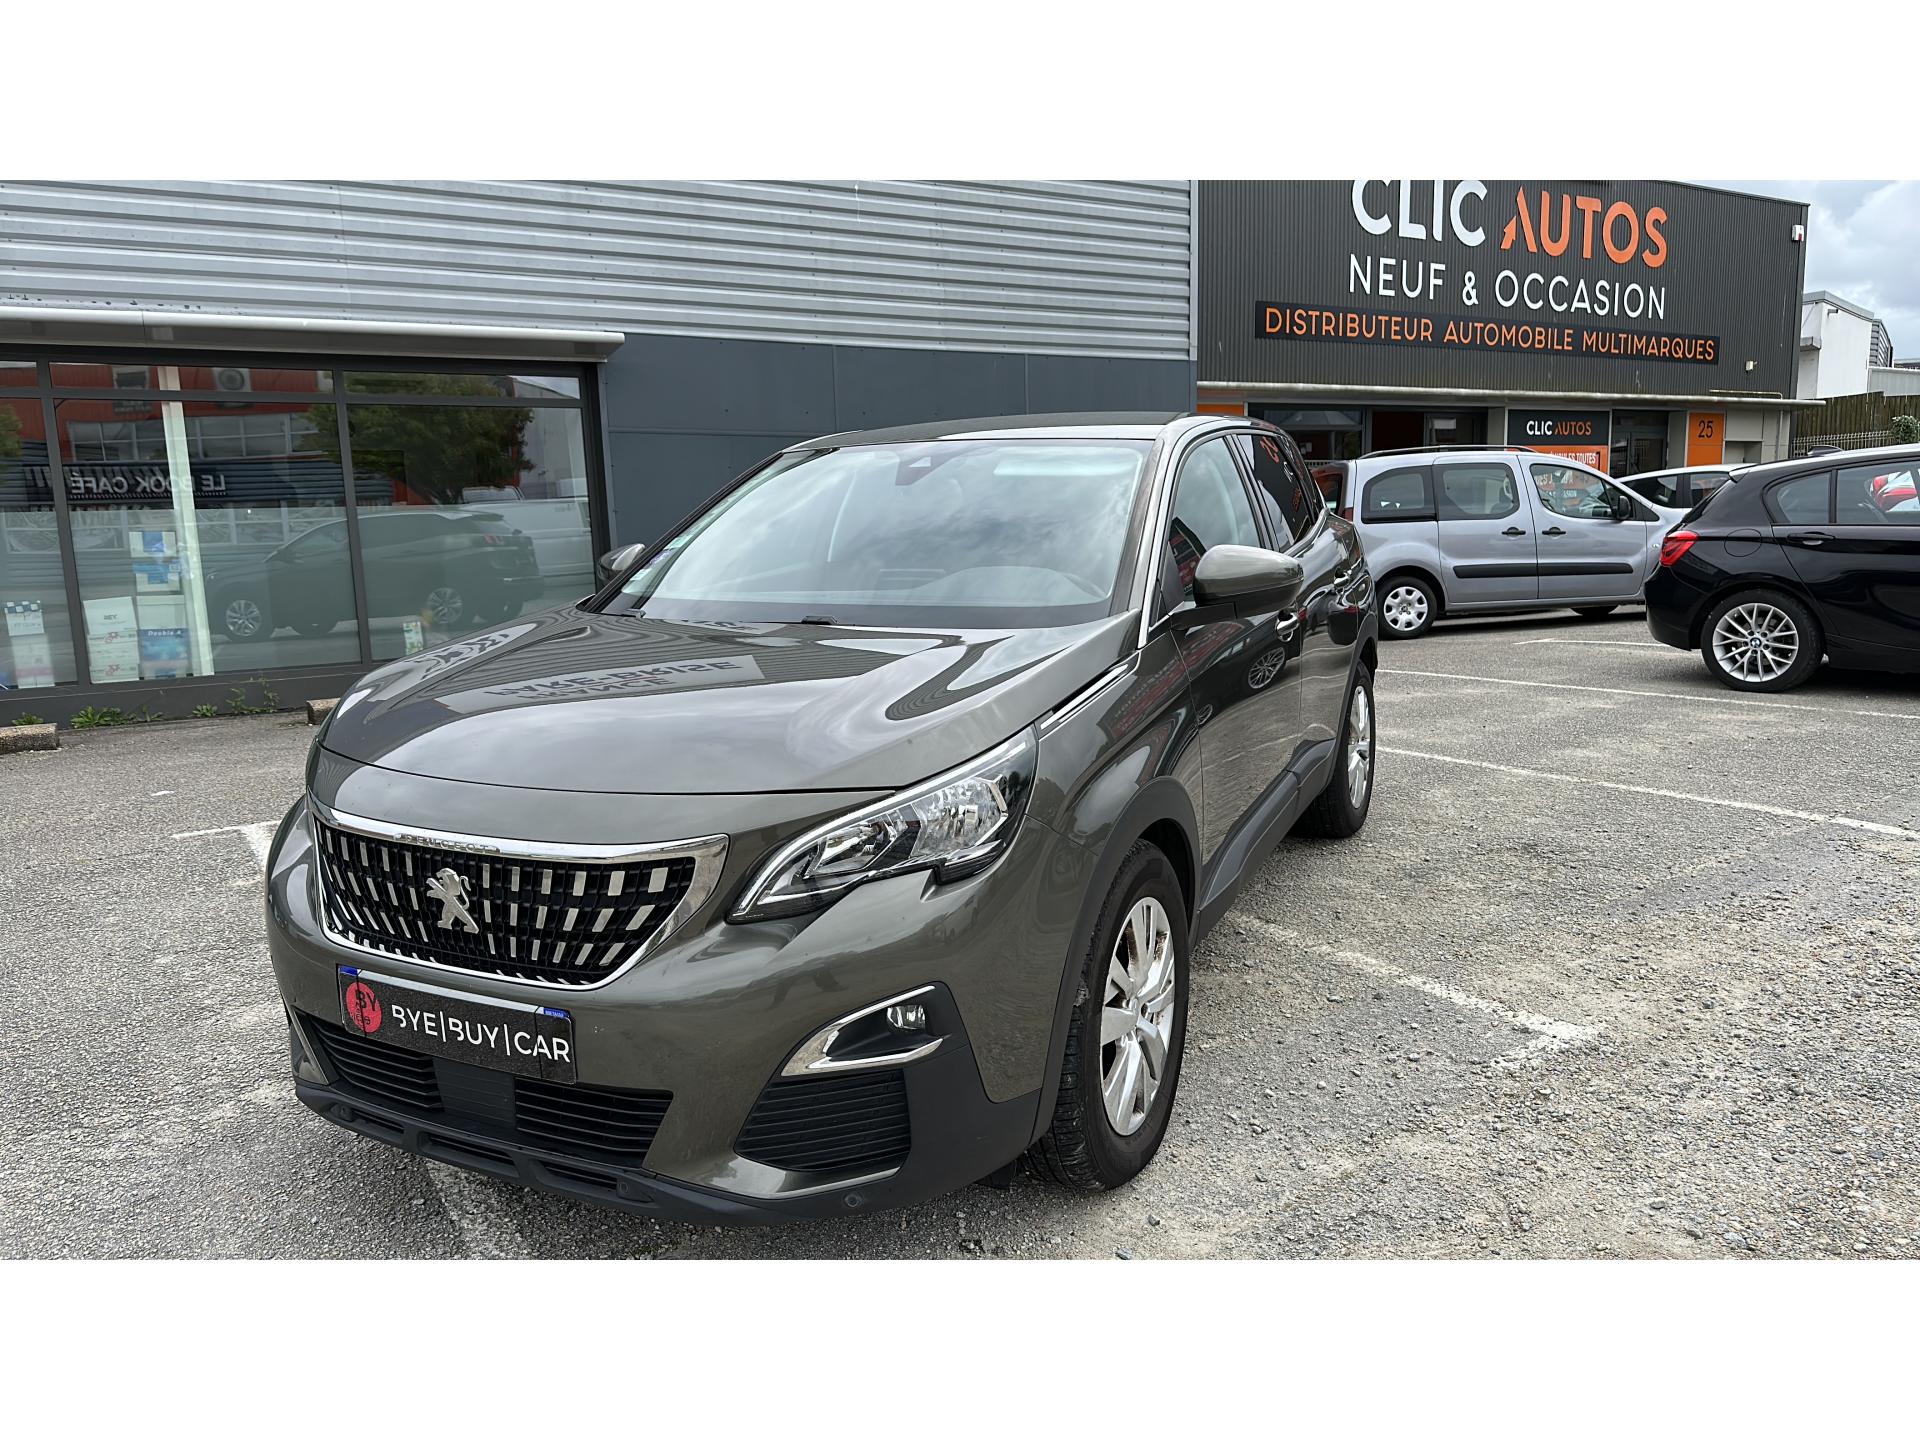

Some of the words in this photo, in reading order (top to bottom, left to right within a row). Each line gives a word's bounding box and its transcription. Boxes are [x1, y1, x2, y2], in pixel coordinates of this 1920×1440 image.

[1351, 180, 1488, 247] CLIC
[1501, 185, 1668, 268] AUTOS
[1349, 253, 1446, 300] NEUF
[1462, 270, 1479, 306] &
[1495, 269, 1666, 320] OCCASION
[1265, 306, 1434, 342] DISTRIBUTEUR
[1444, 320, 1573, 351] AUTOMOBILE
[1583, 331, 1715, 361] MULTIMARQUES
[1526, 420, 1553, 436] CLIC
[1555, 421, 1592, 436] AUTOS
[1698, 420, 1714, 438] 25
[1576, 452, 1596, 464] TOUTES
